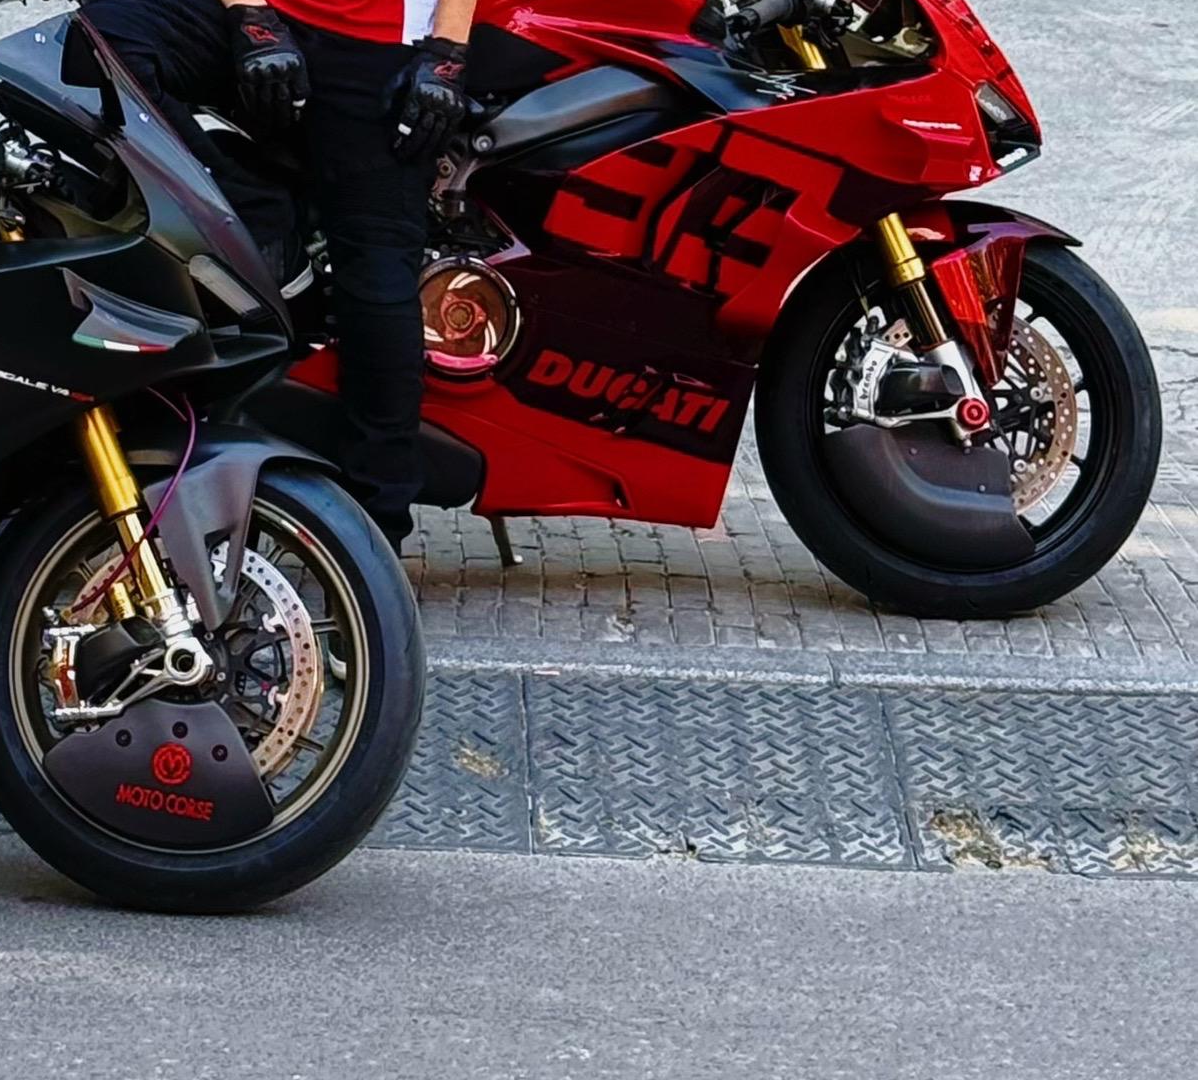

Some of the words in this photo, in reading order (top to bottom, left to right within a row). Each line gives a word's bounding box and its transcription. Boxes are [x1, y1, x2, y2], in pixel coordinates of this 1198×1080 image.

[526, 348, 731, 433] DUCATI
[115, 783, 163, 812] MOTO
[165, 793, 216, 822] CORSE
